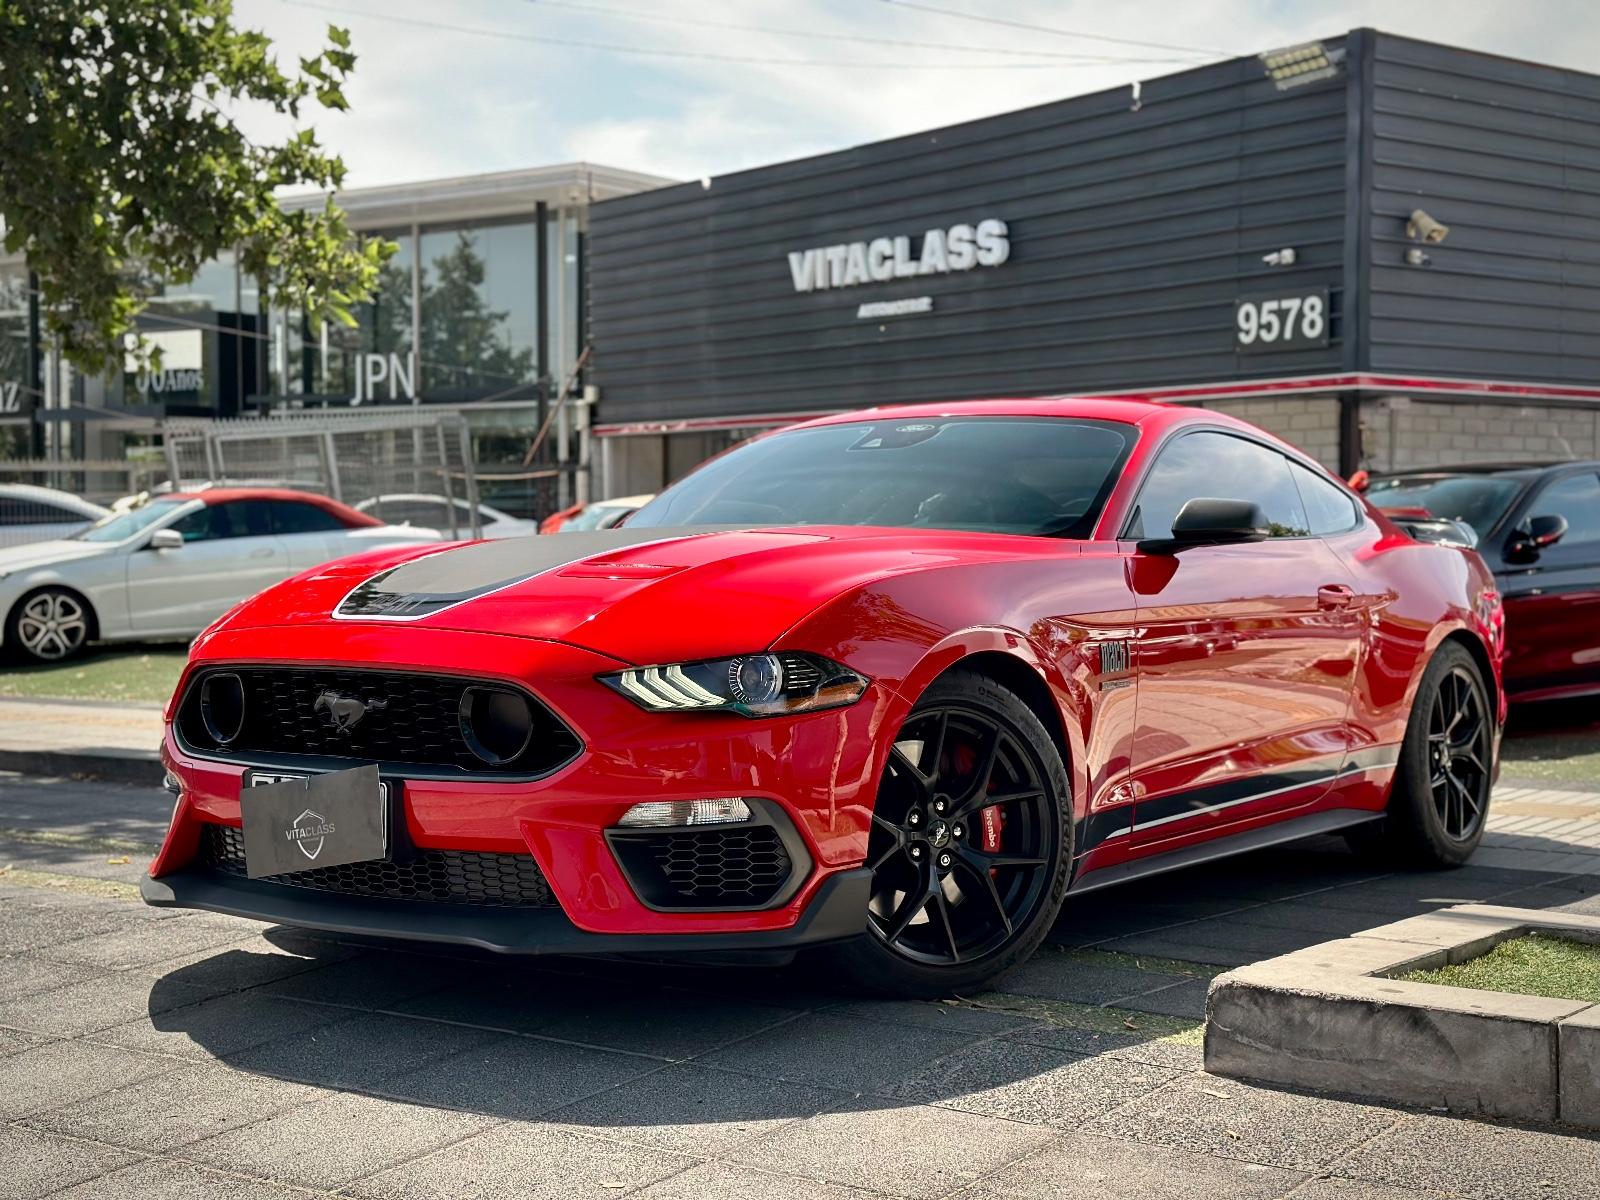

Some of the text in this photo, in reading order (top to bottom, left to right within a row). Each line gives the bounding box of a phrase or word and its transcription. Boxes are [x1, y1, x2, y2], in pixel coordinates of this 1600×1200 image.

[788, 219, 1010, 291] VITACLASS
[1237, 295, 1324, 344] 9578
[350, 352, 415, 406] JPN
[285, 823, 336, 841] VITACLASS
[985, 809, 997, 848] brembo
